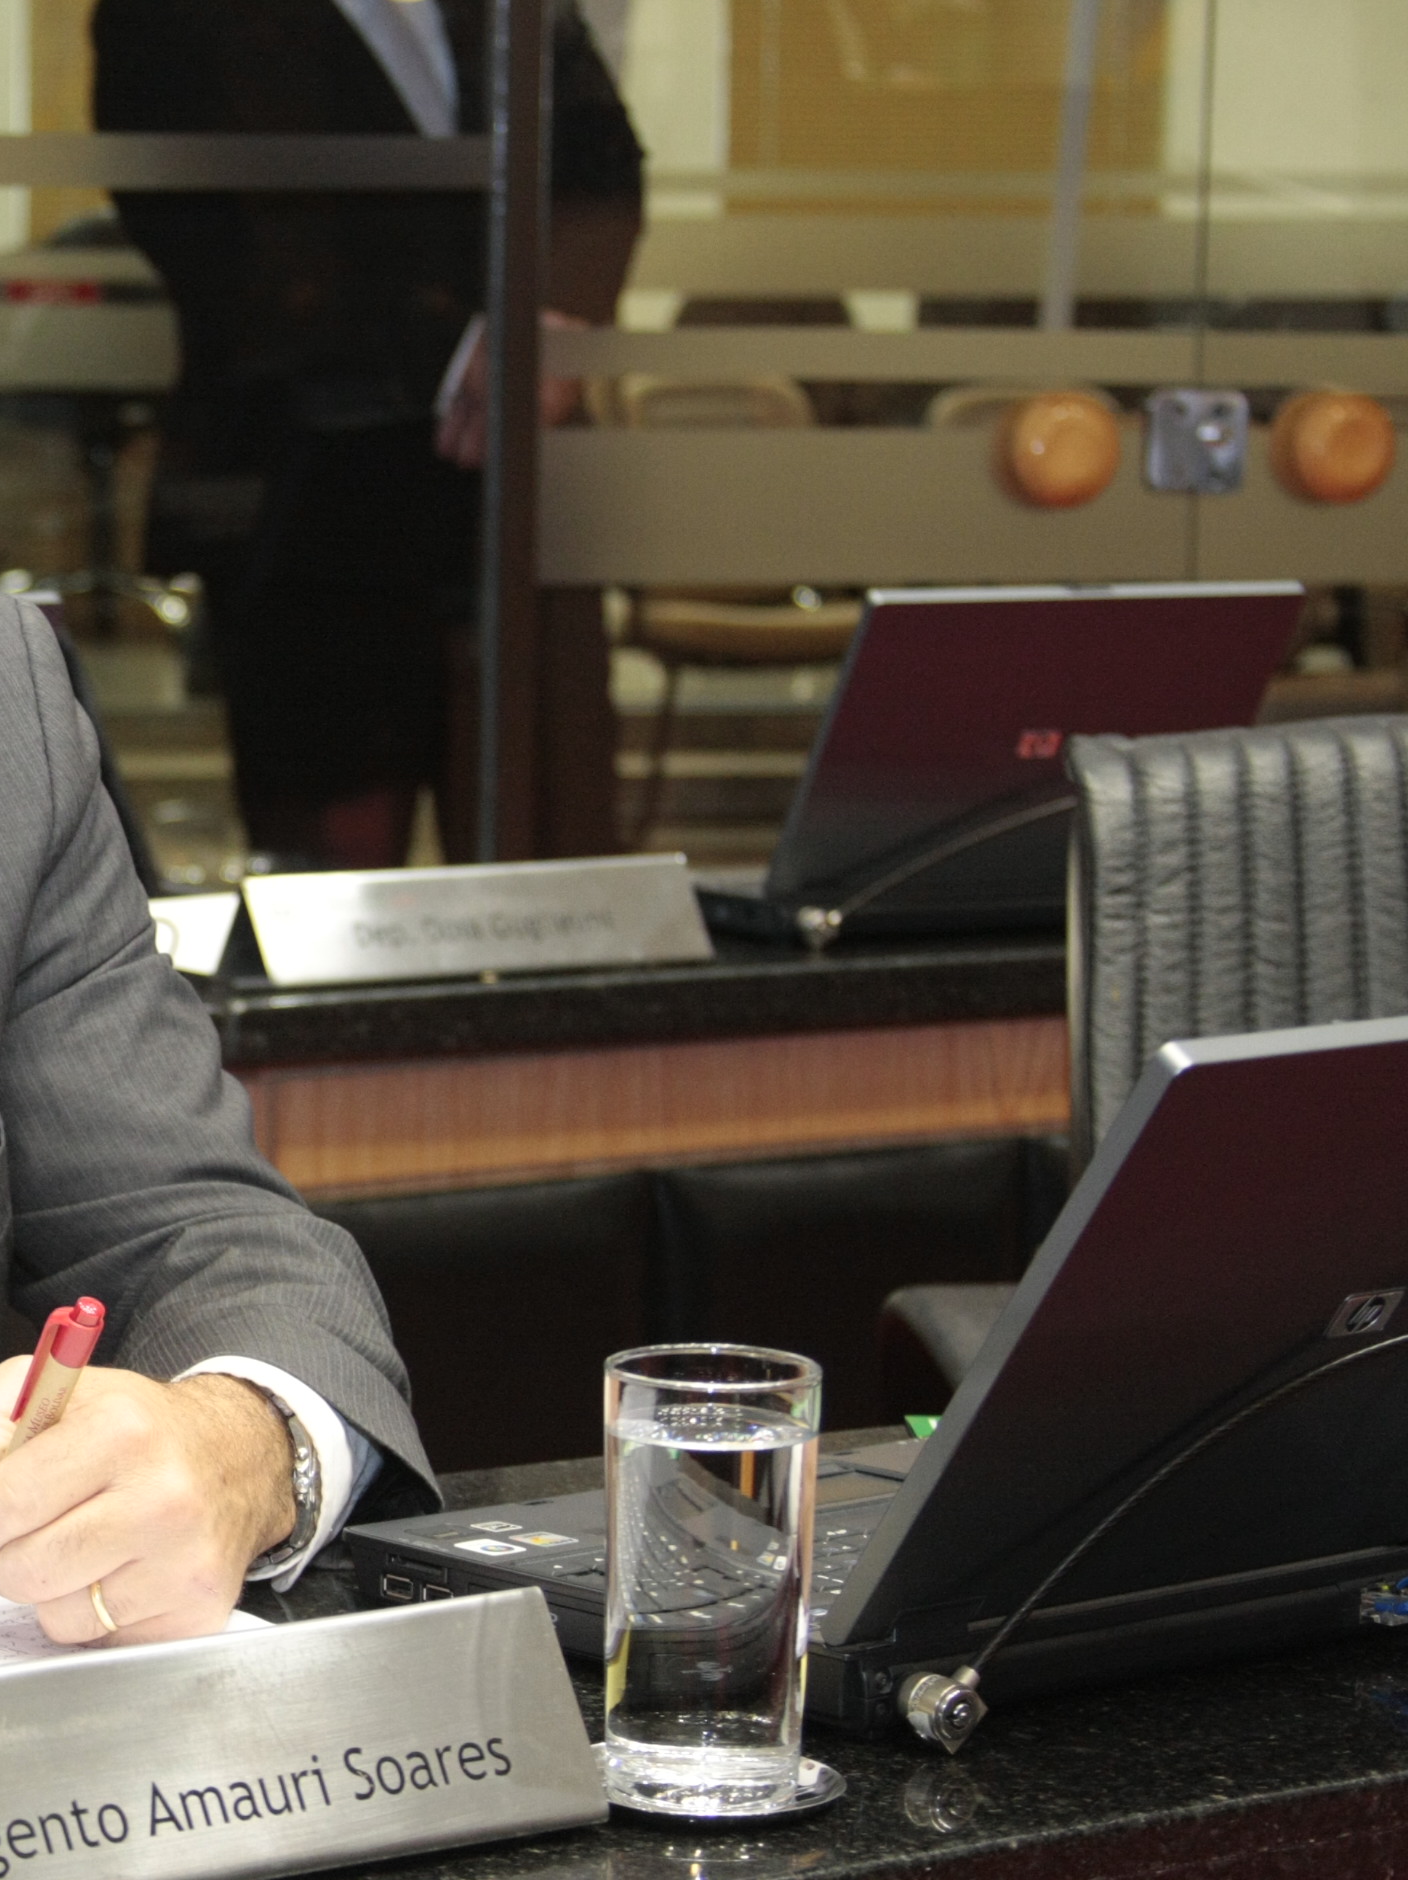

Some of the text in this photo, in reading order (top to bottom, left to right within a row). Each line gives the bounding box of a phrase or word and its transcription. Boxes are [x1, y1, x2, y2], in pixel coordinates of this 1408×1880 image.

[27, 1397, 50, 1433] MUSEO
[148, 1754, 332, 1837] Amauri
[342, 1736, 513, 1801] Soares
